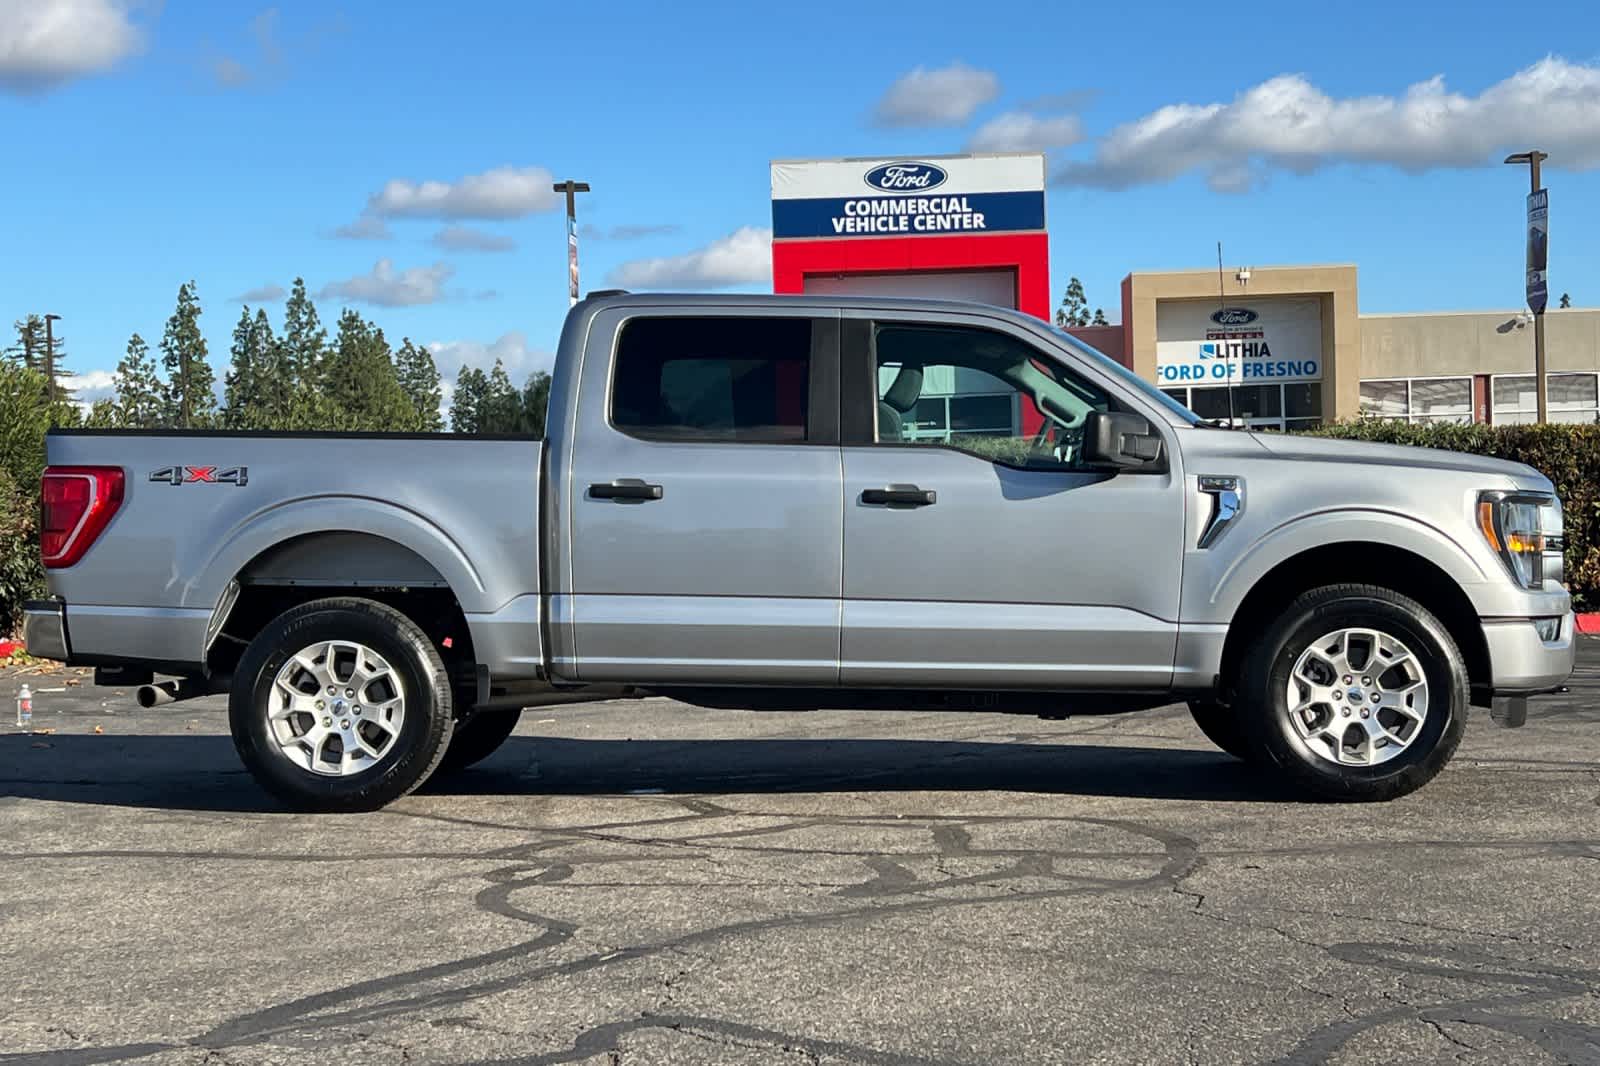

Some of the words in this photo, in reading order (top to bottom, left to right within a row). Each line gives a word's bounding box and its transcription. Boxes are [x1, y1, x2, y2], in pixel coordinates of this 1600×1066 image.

[881, 166, 931, 188] Ford
[844, 197, 973, 216] COMMERCIAL
[831, 216, 909, 233] VEHICLE
[913, 213, 986, 231] CENTER
[1219, 309, 1249, 324] Ford
[1215, 342, 1271, 359] LITHIA
[1211, 363, 1236, 379] OF
[1242, 360, 1318, 377] FRESNO
